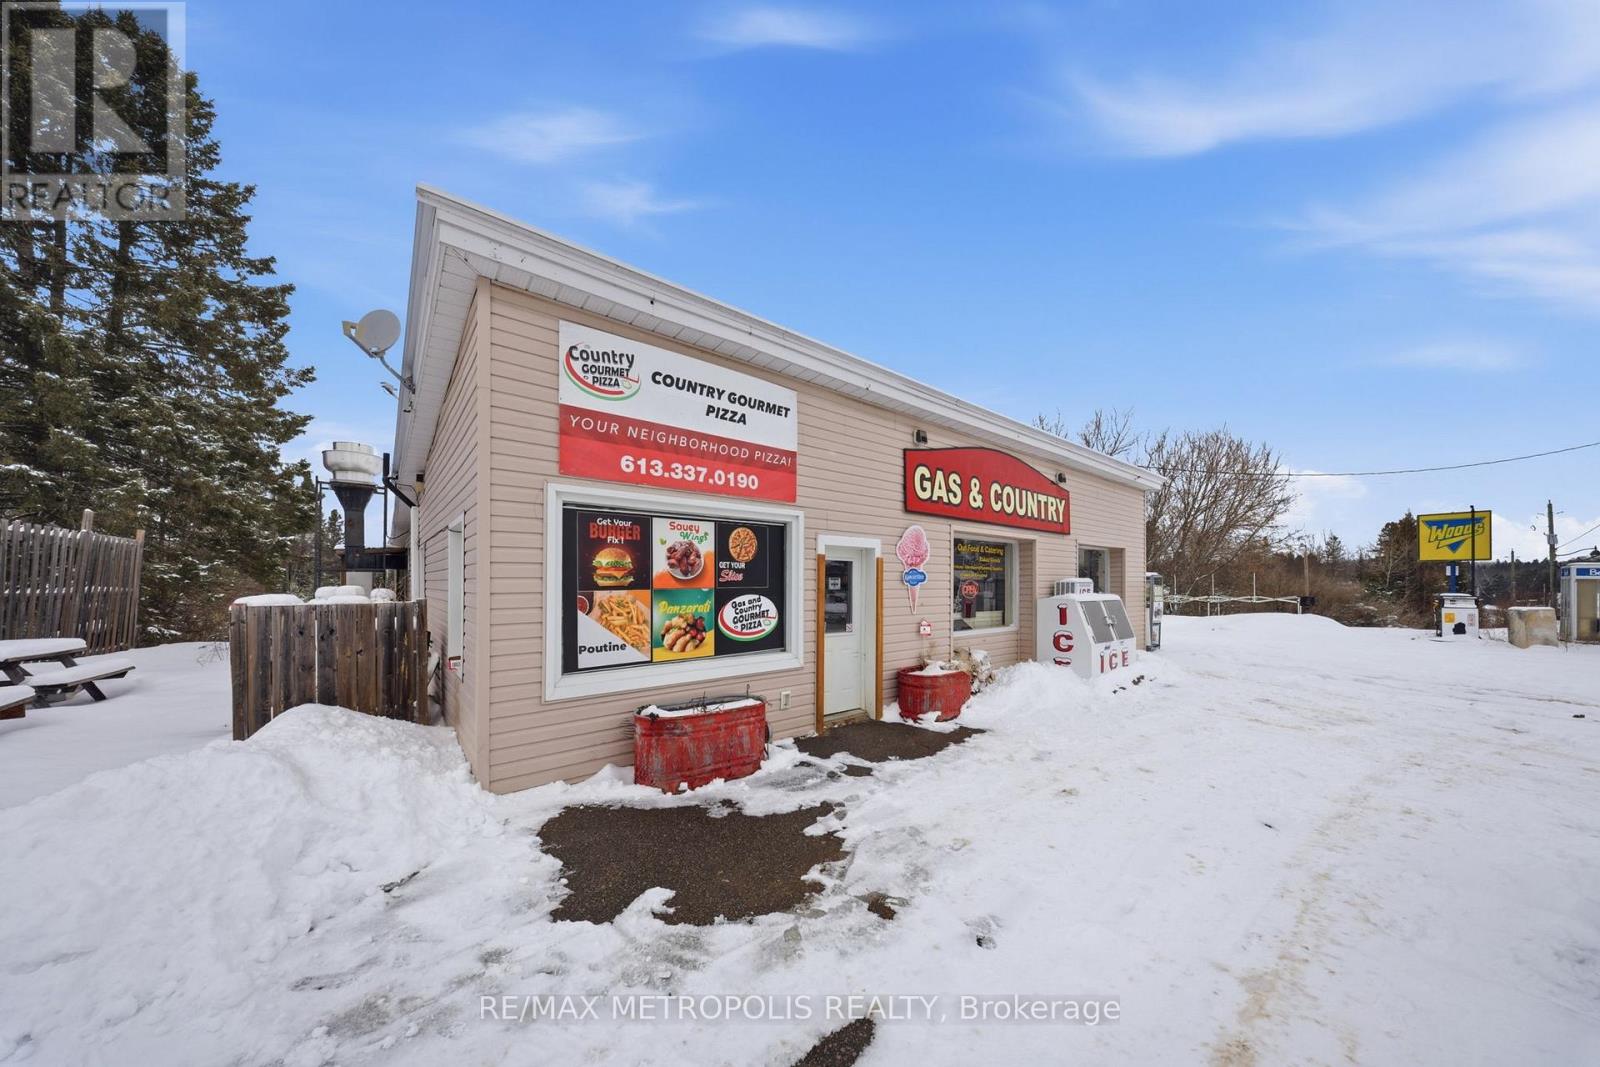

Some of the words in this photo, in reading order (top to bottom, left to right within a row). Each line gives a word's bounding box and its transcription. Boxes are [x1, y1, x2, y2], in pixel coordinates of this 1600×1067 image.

[568, 346, 635, 369] Country
[581, 364, 630, 378] GOURMET
[592, 376, 620, 387] PIZZA
[651, 371, 726, 401] COUNTRY
[727, 392, 790, 418] GOURMET
[705, 404, 747, 425] PIZZA
[569, 415, 620, 436] YOUR
[627, 426, 749, 458] NEIGHBORHOOD
[754, 451, 792, 467] PIZZA!
[620, 455, 760, 490] 613.337.0190
[913, 464, 962, 505] GAS
[969, 475, 984, 510] &
[989, 480, 1067, 524] COUNTRY
[596, 517, 612, 526] Get
[613, 519, 633, 527] Your
[589, 522, 641, 540] BURGER
[680, 531, 709, 545] Wings
[718, 561, 731, 569] GET
[731, 561, 746, 569] YOUR
[731, 601, 746, 609] Gas
[747, 594, 762, 604] and
[734, 603, 763, 615] Country
[732, 609, 770, 625] GOURMET
[740, 620, 763, 632] PIZZA
[1053, 603, 1074, 666] IC
[578, 642, 627, 655] Poutine
[1100, 649, 1129, 674] ICE
